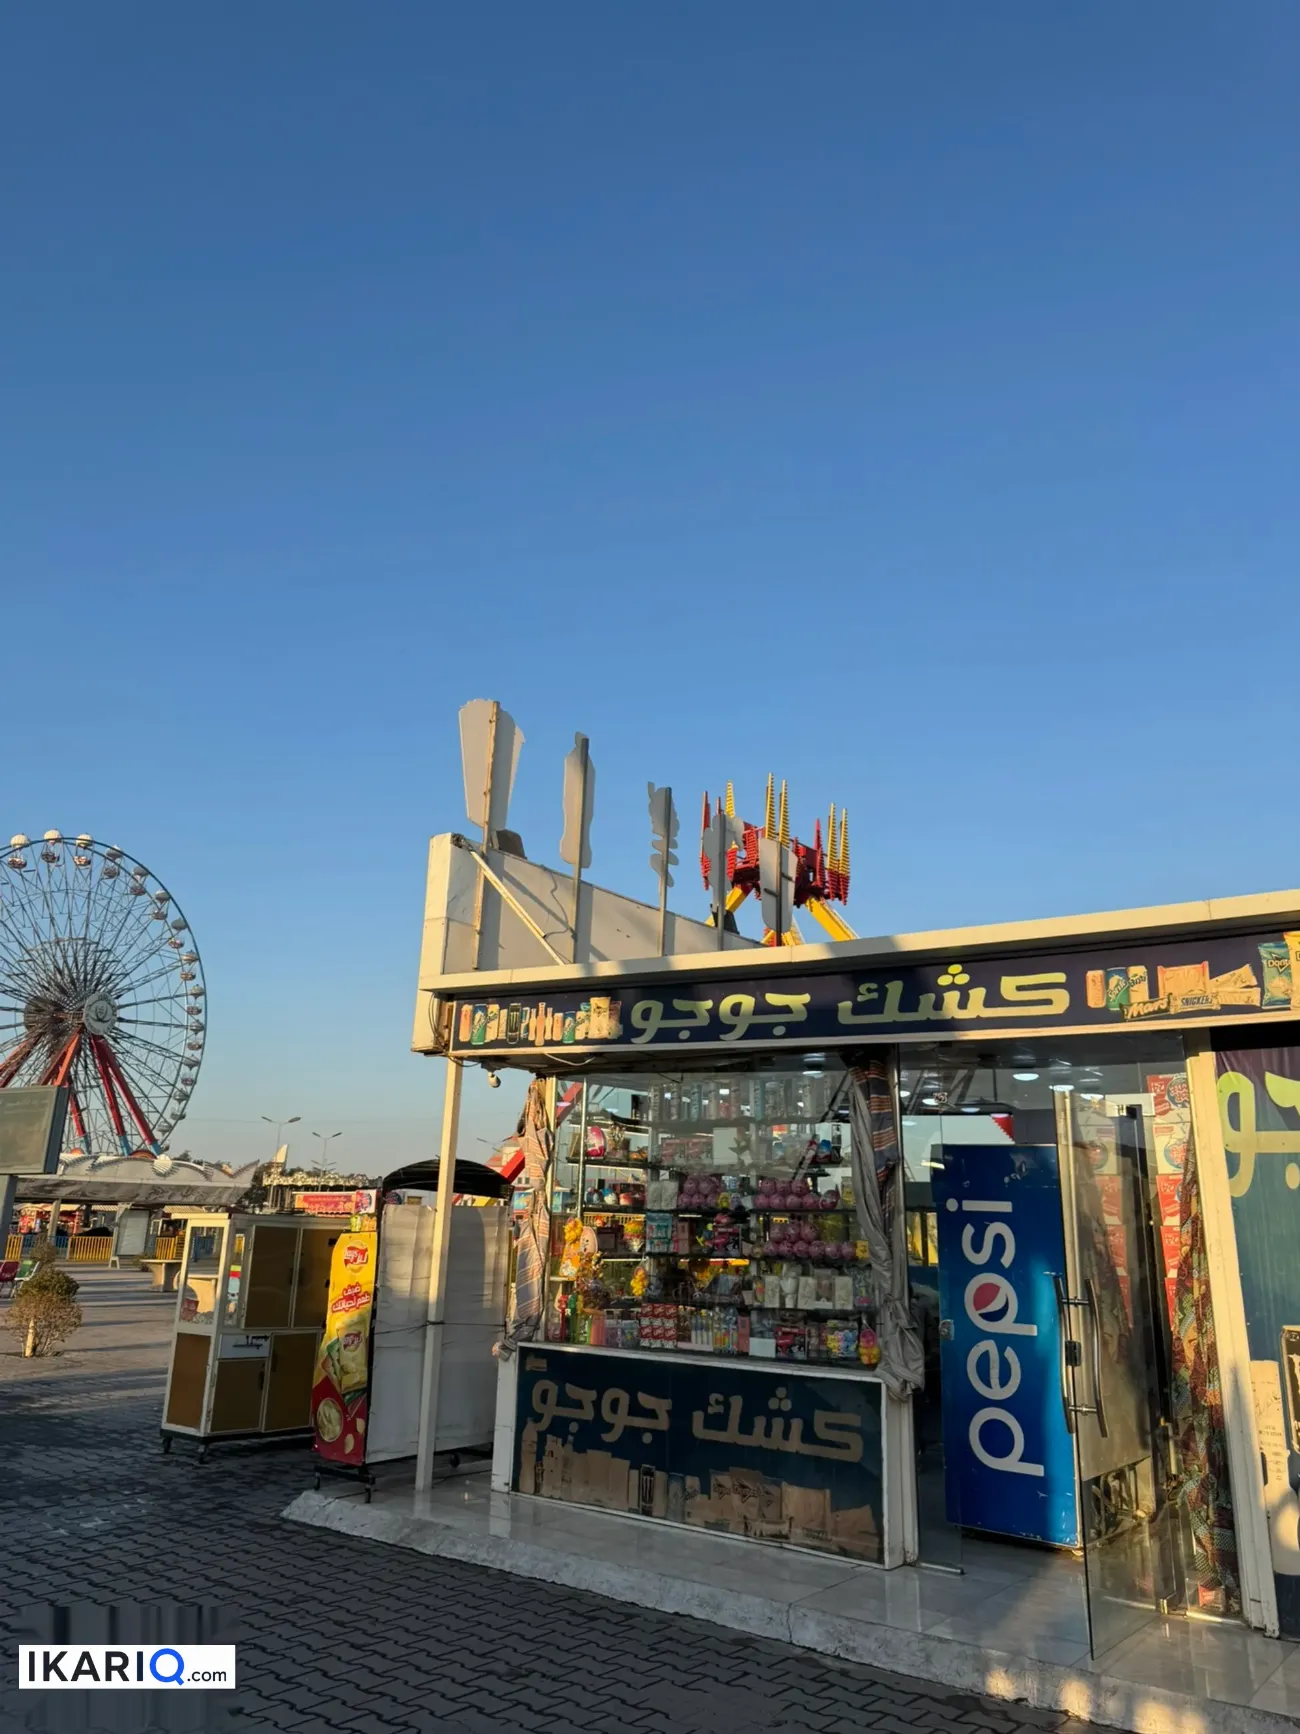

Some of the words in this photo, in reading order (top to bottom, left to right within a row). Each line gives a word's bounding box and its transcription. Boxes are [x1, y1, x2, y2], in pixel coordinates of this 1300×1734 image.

[630, 992, 812, 1045] جوجو
[837, 964, 1071, 1026] كشك
[1127, 997, 1168, 1019] Mars
[945, 1198, 1045, 1478] pepsi
[531, 1379, 672, 1444] جوجو
[692, 1387, 863, 1463] كشك
